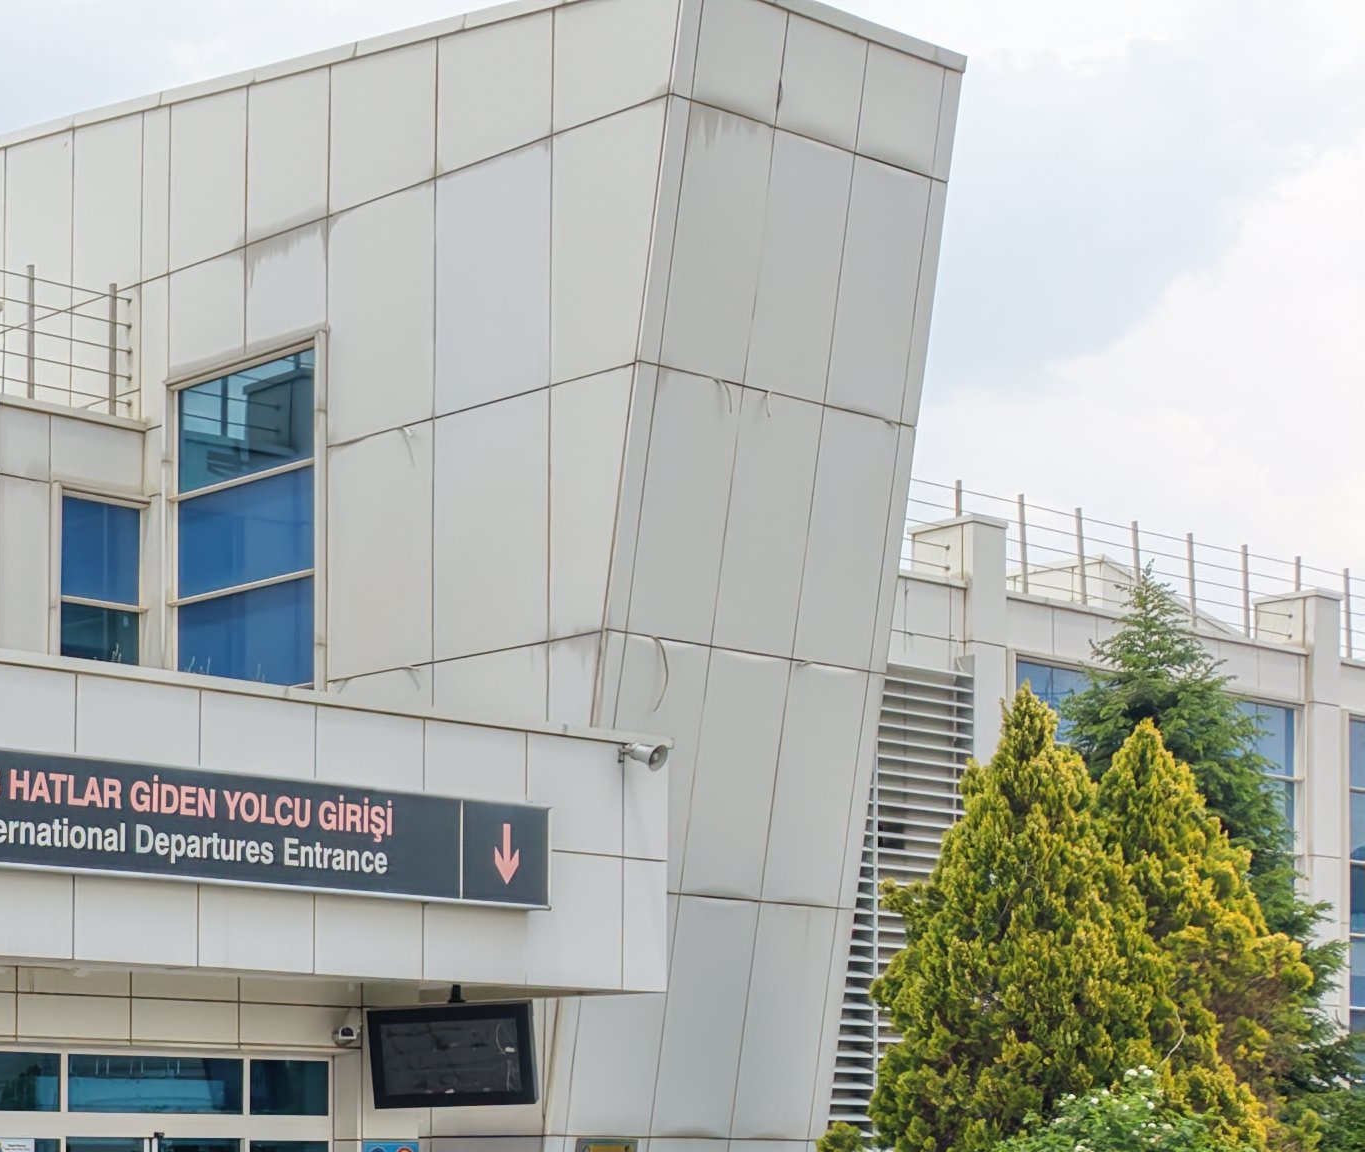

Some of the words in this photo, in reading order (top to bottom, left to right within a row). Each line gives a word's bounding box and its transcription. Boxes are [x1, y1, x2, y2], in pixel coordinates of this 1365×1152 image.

[9, 768, 122, 810] HATLAR
[130, 775, 216, 819] GİDEN
[223, 790, 312, 828] YOLCU
[318, 795, 393, 843] GİRİŞİ
[135, 824, 274, 865] Departures
[283, 837, 388, 875] Entrance
